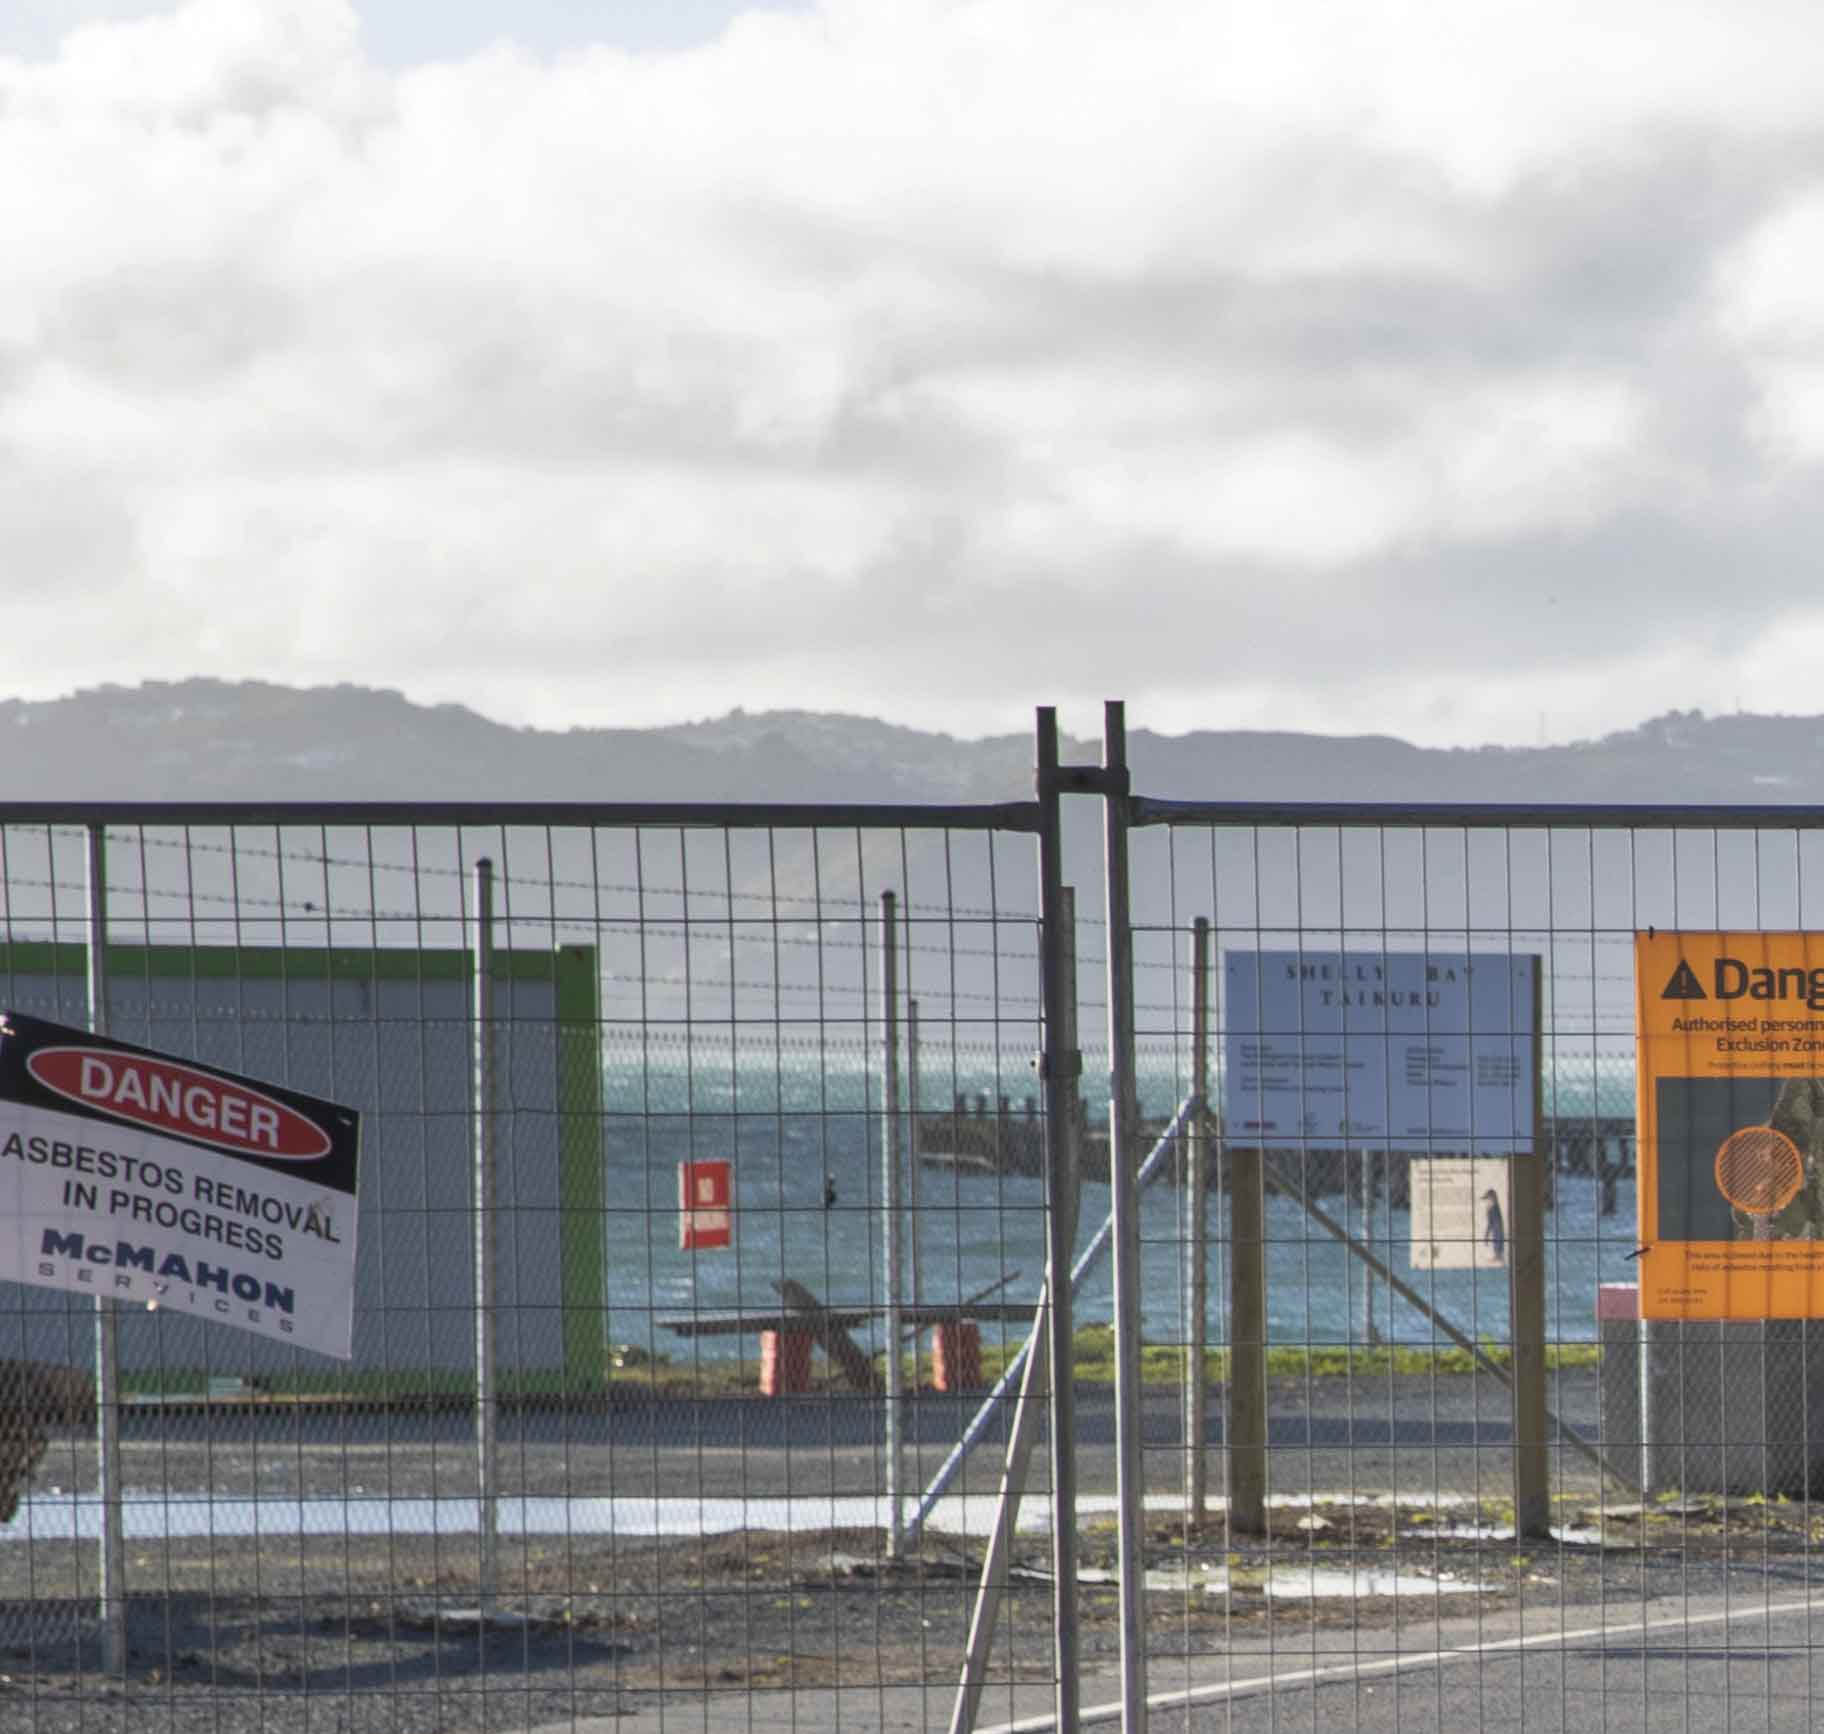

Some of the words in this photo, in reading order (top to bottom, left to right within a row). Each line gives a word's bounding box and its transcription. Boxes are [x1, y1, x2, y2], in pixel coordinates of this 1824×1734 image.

[1286, 964, 1387, 981] SHELY
[1671, 1017, 1758, 1032] Authorised
[1716, 1038, 1789, 1052] Exclusion
[79, 1056, 281, 1149] DANGER
[2, 1133, 184, 1195] ASBESTOS
[194, 1175, 341, 1244] REMOVAL
[63, 1180, 97, 1210] IN
[109, 1190, 284, 1261] PROGRESS
[38, 1262, 294, 1333] SERVICES
[41, 1228, 295, 1314] McMAHON
